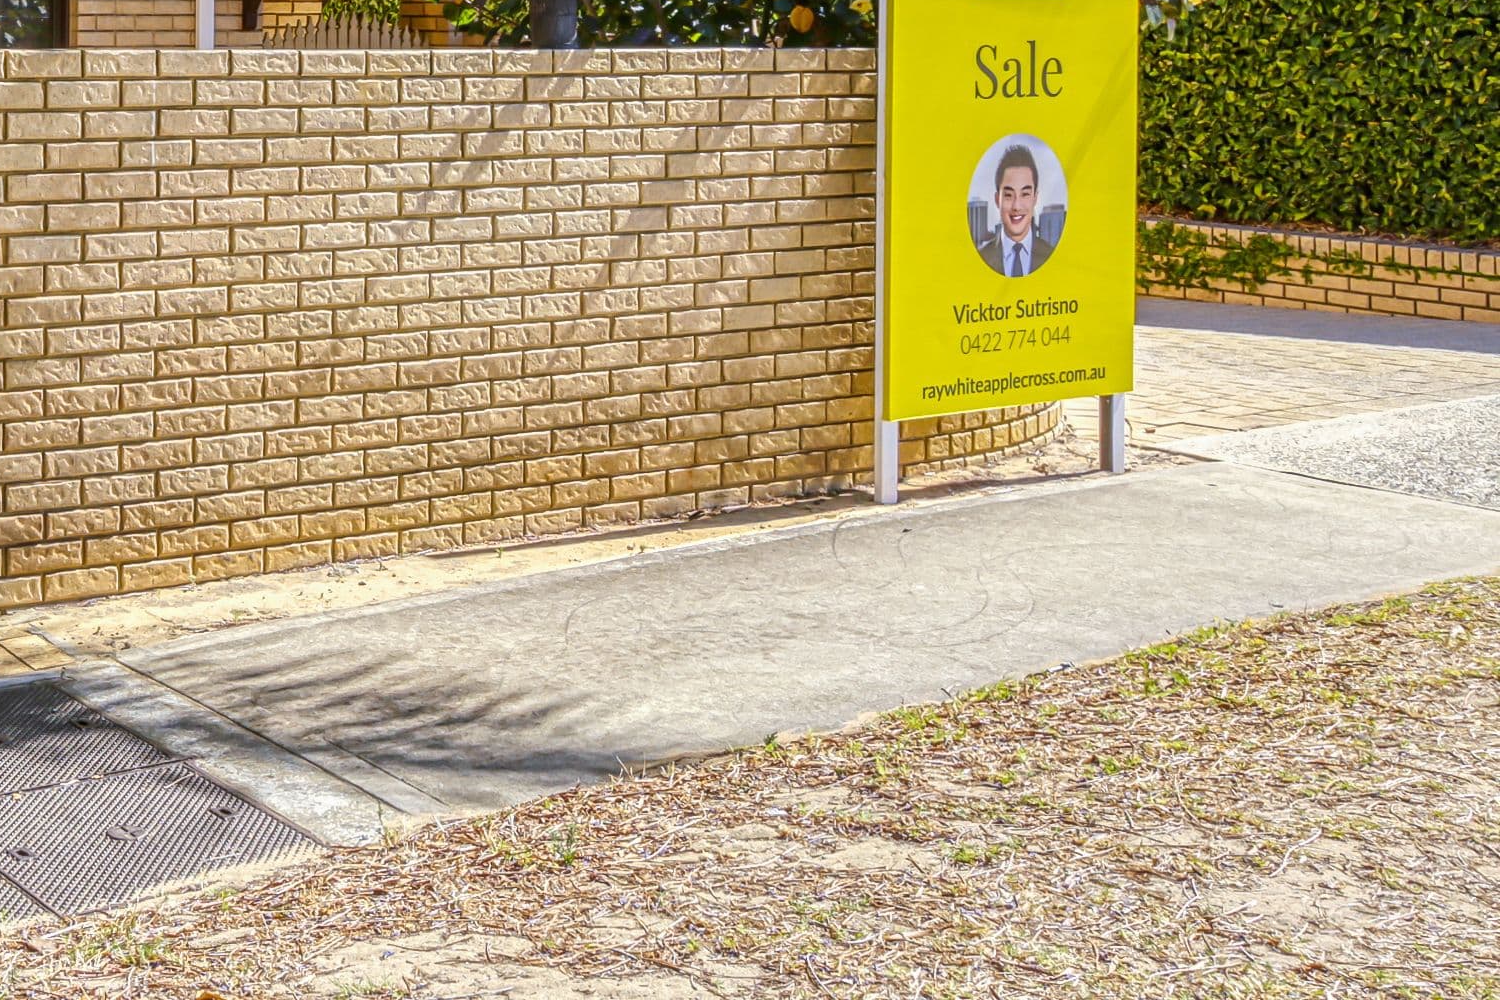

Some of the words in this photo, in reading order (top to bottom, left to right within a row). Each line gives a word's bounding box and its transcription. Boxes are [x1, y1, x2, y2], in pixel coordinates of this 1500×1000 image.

[975, 40, 1063, 100] Sale
[953, 303, 1011, 325] Vicktor
[1015, 297, 1079, 319] Sutrisno
[960, 332, 1002, 355] 0422
[1007, 329, 1037, 350] 774
[1041, 325, 1072, 347] 044
[922, 366, 1106, 401] raywhiteapplecross.com.au
